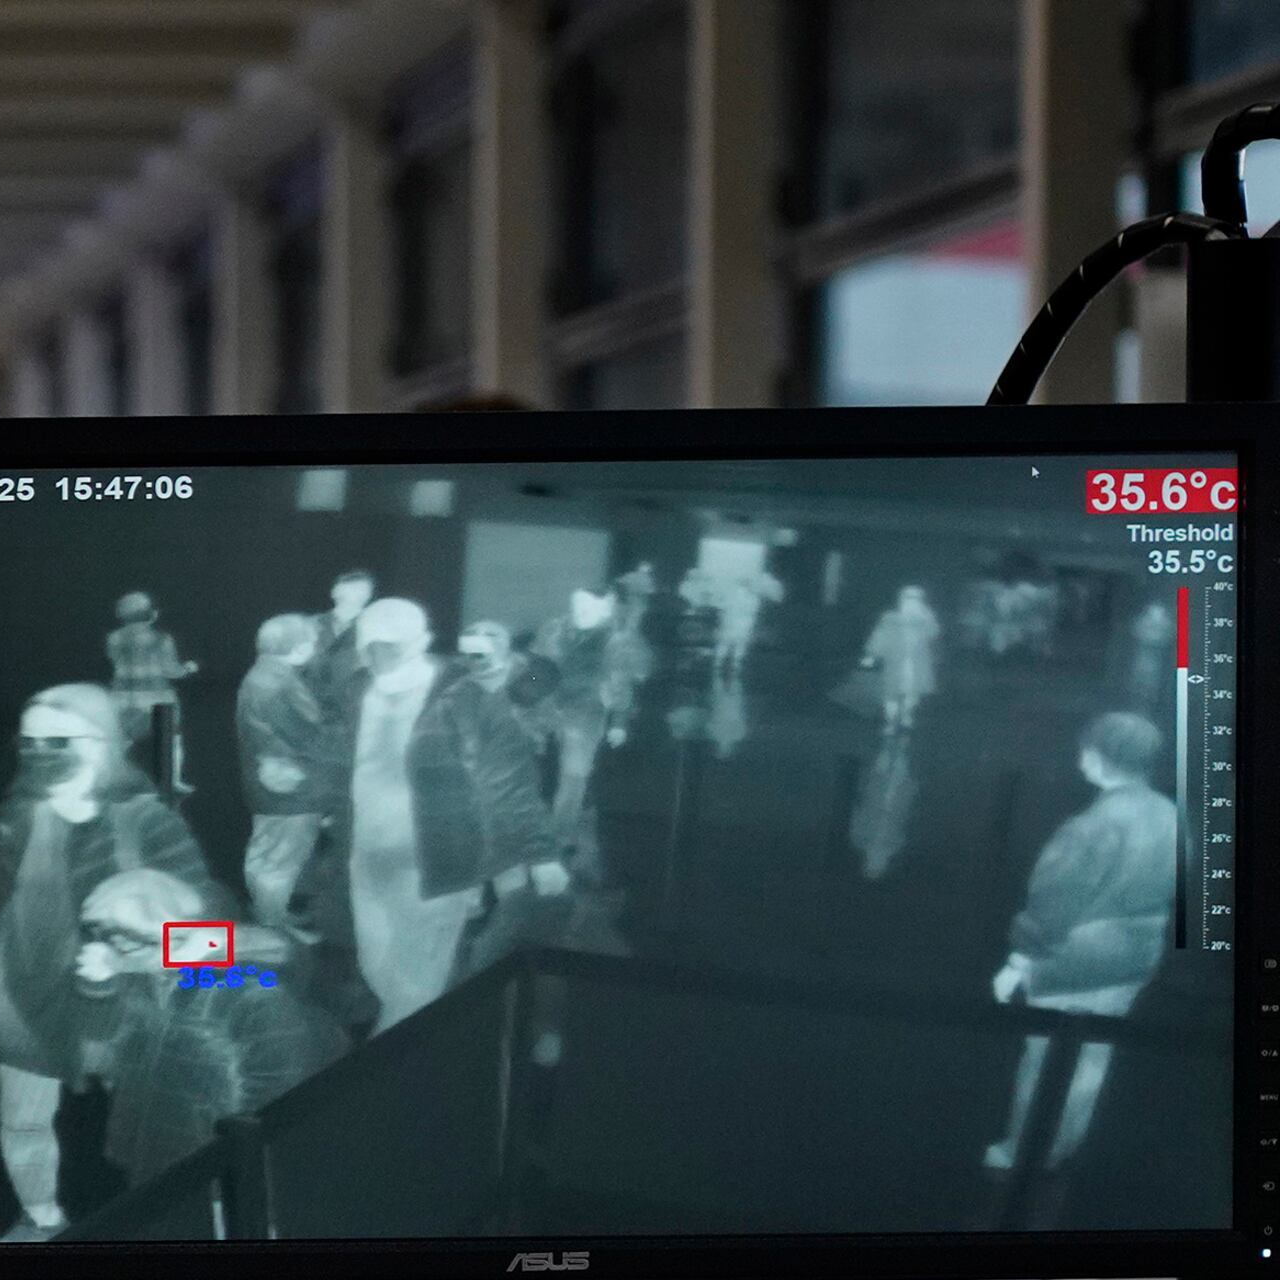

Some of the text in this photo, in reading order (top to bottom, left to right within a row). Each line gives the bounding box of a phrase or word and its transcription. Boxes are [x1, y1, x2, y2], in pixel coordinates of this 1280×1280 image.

[55, 475, 194, 501] 15:47:06
[1126, 523, 1234, 542] Threshold
[505, 1251, 590, 1273] ASUS
